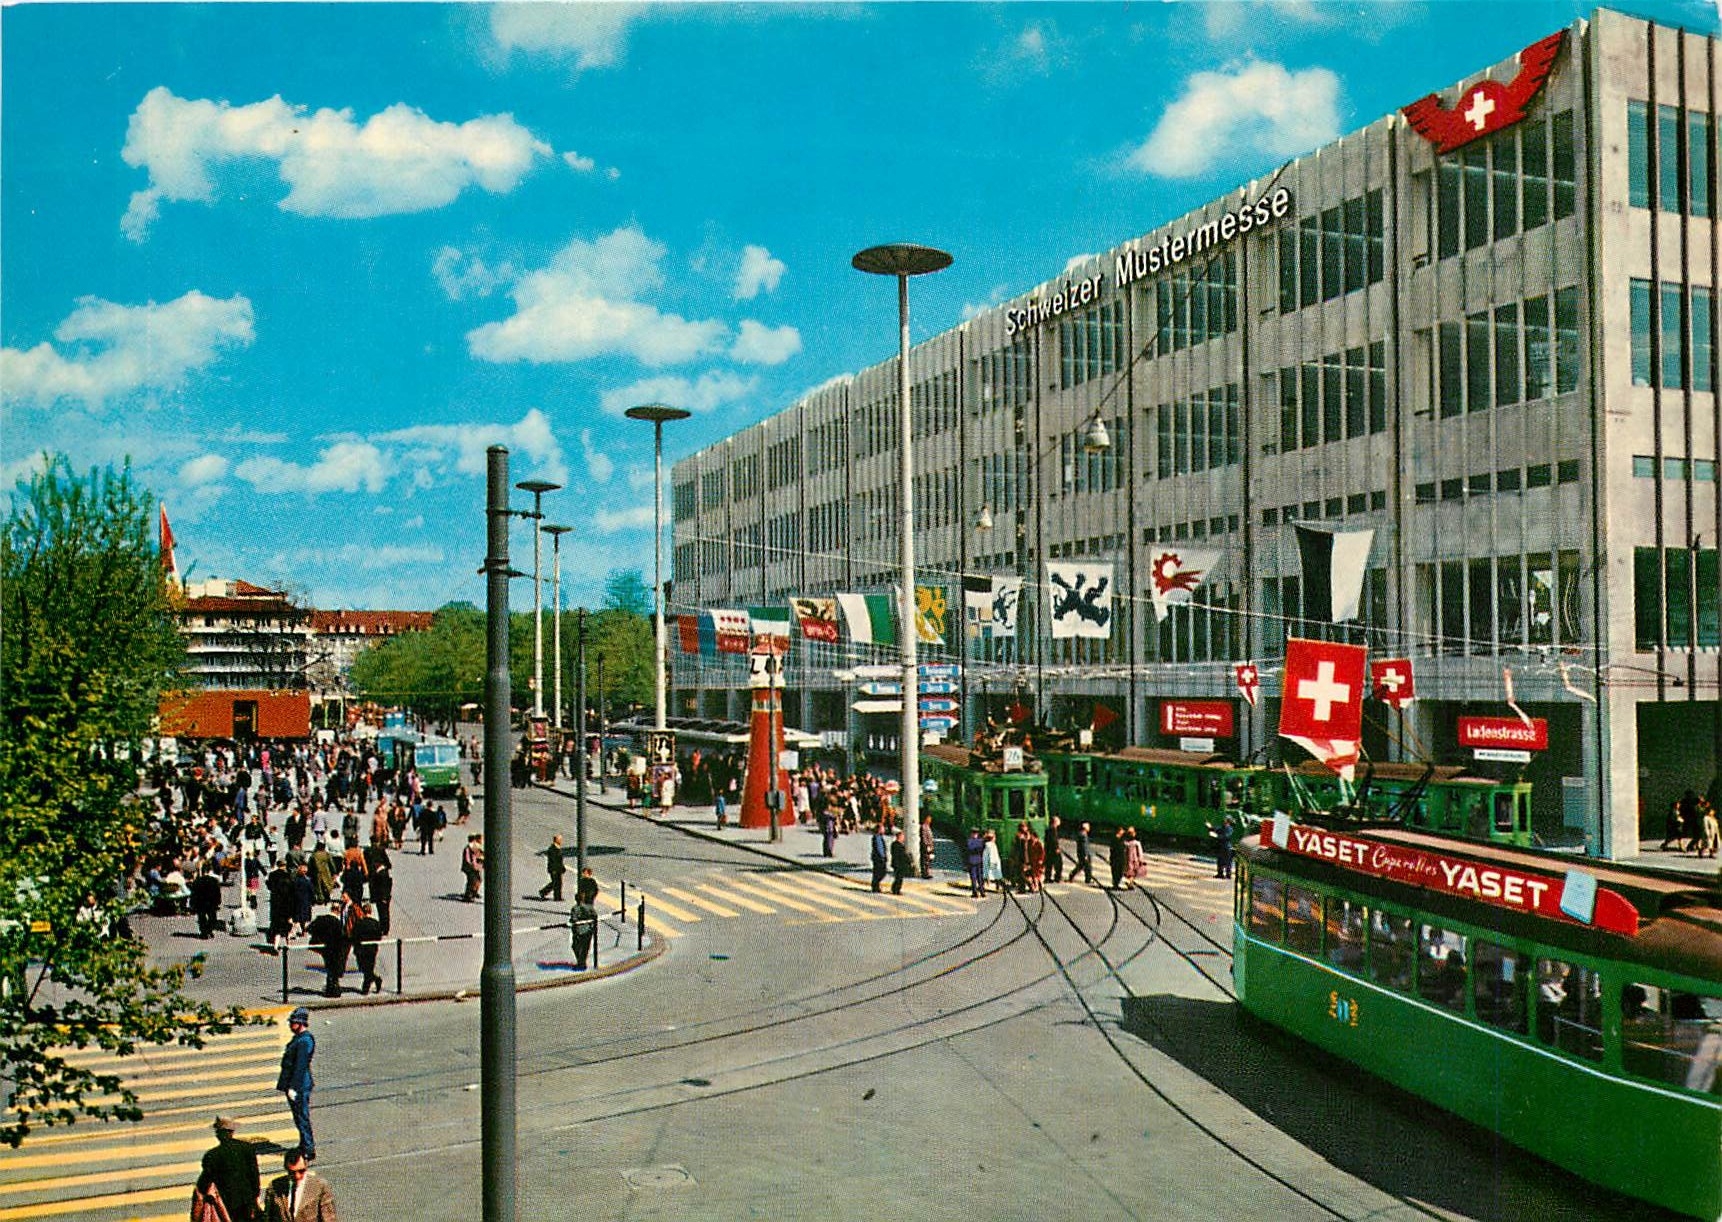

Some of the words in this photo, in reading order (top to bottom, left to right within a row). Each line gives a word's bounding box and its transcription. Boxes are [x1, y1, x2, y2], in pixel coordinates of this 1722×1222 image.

[1006, 273, 1102, 335] Schweizer
[1115, 187, 1290, 288] Mustermesse
[1466, 724, 1536, 741] Ladenstrasse
[1293, 829, 1369, 864] YASET
[1440, 860, 1549, 908] YASET
